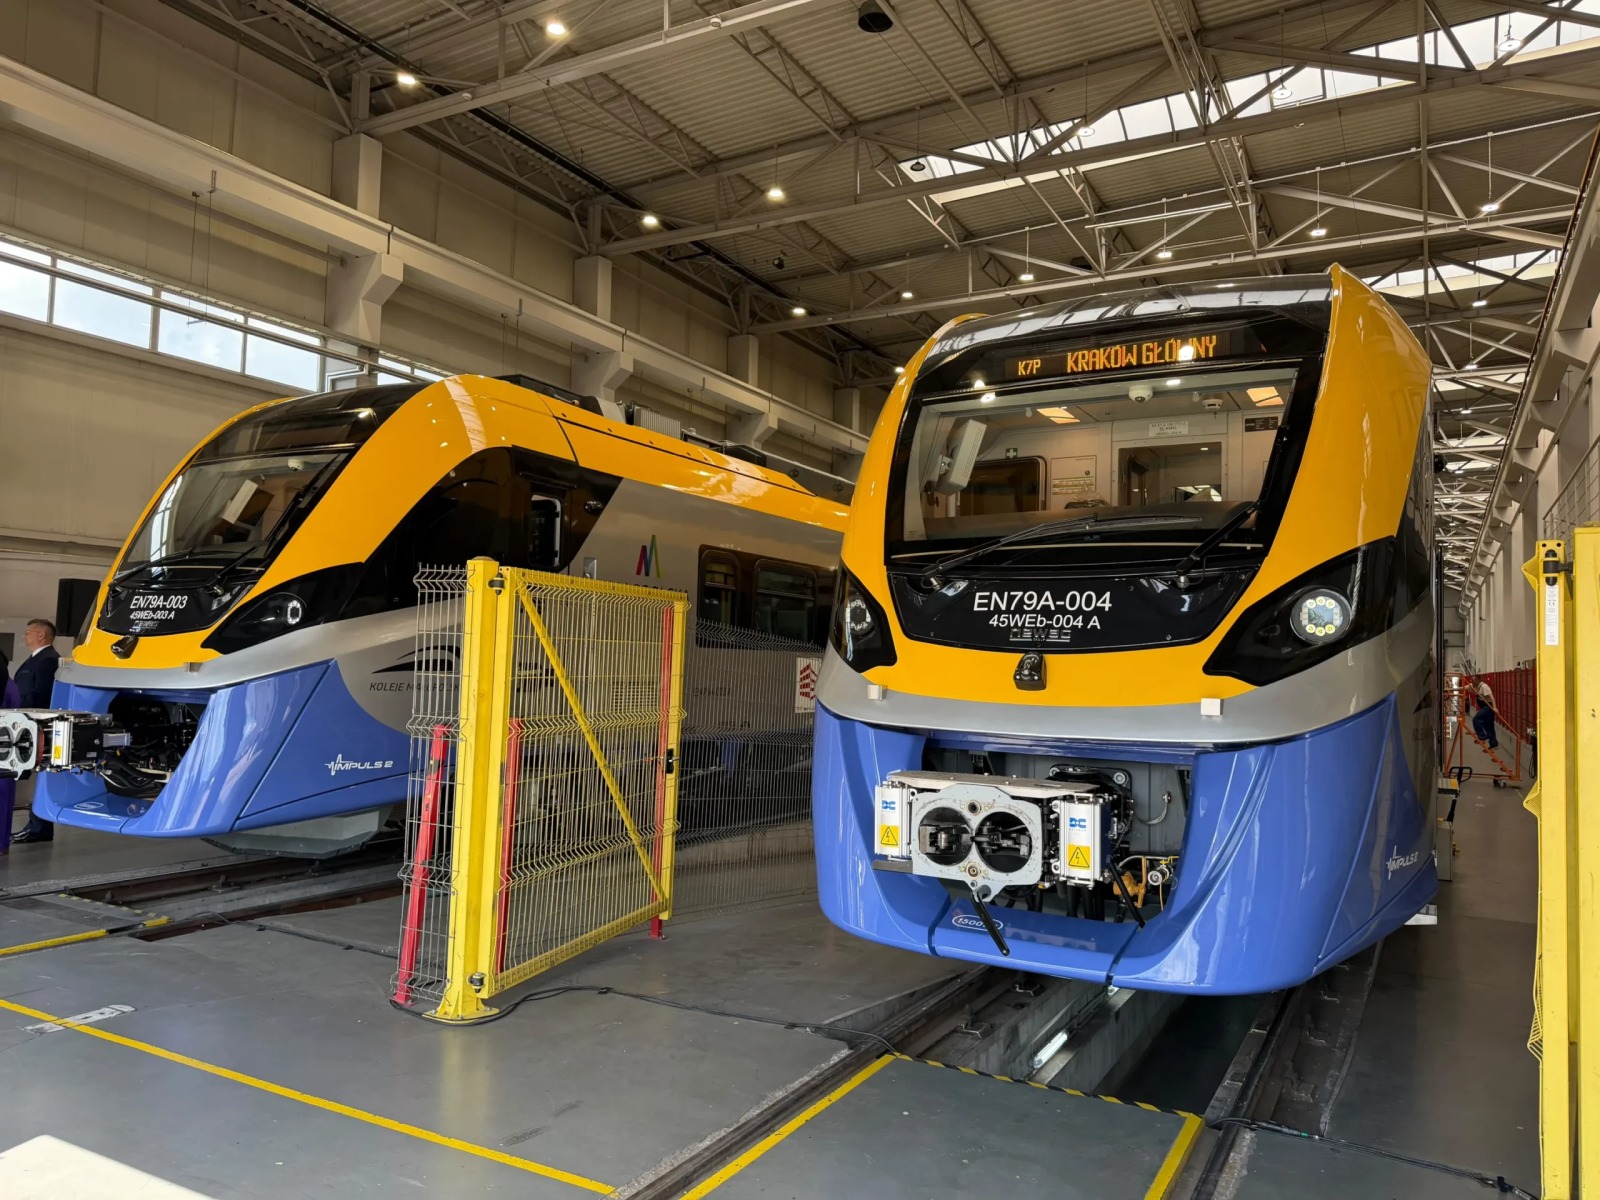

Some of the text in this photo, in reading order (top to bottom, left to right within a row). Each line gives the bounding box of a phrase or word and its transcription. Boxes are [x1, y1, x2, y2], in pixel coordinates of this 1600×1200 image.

[1018, 359, 1041, 376] K7P
[1067, 344, 1137, 373] KRAKÓW
[130, 595, 188, 609] EN79A-003
[973, 591, 1112, 612] EN79A-004
[129, 611, 175, 620] 45WEb-003 A
[989, 614, 1101, 630] 45WEb-004 A
[369, 682, 404, 692] KOLEJE
[330, 757, 394, 773] IMPULS 2
